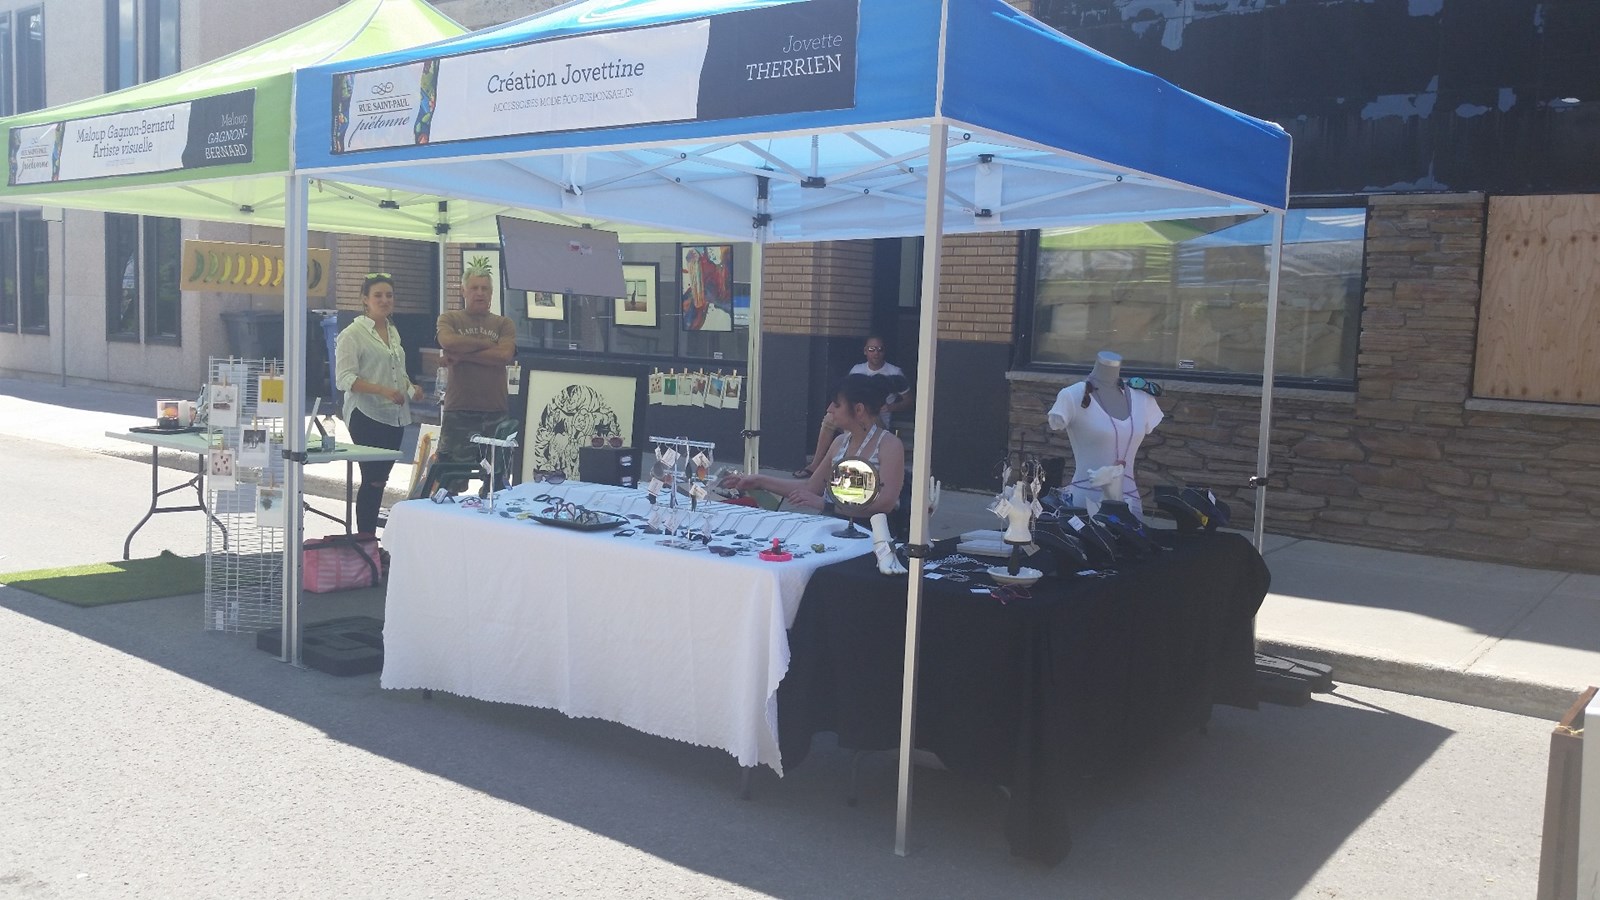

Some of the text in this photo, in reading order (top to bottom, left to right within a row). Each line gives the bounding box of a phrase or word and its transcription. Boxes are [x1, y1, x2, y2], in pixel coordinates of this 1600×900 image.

[782, 33, 843, 54] Jovette
[487, 58, 645, 94] Création Jovettine
[746, 53, 842, 81] THERRIEN
[358, 98, 410, 113] RUE SAINT-PAUL
[76, 113, 175, 144] Maloup Gagnon-Bernard
[207, 127, 248, 144] GAGNON-
[92, 136, 153, 158] Artiste visuelle
[205, 143, 248, 159] BERNARD
